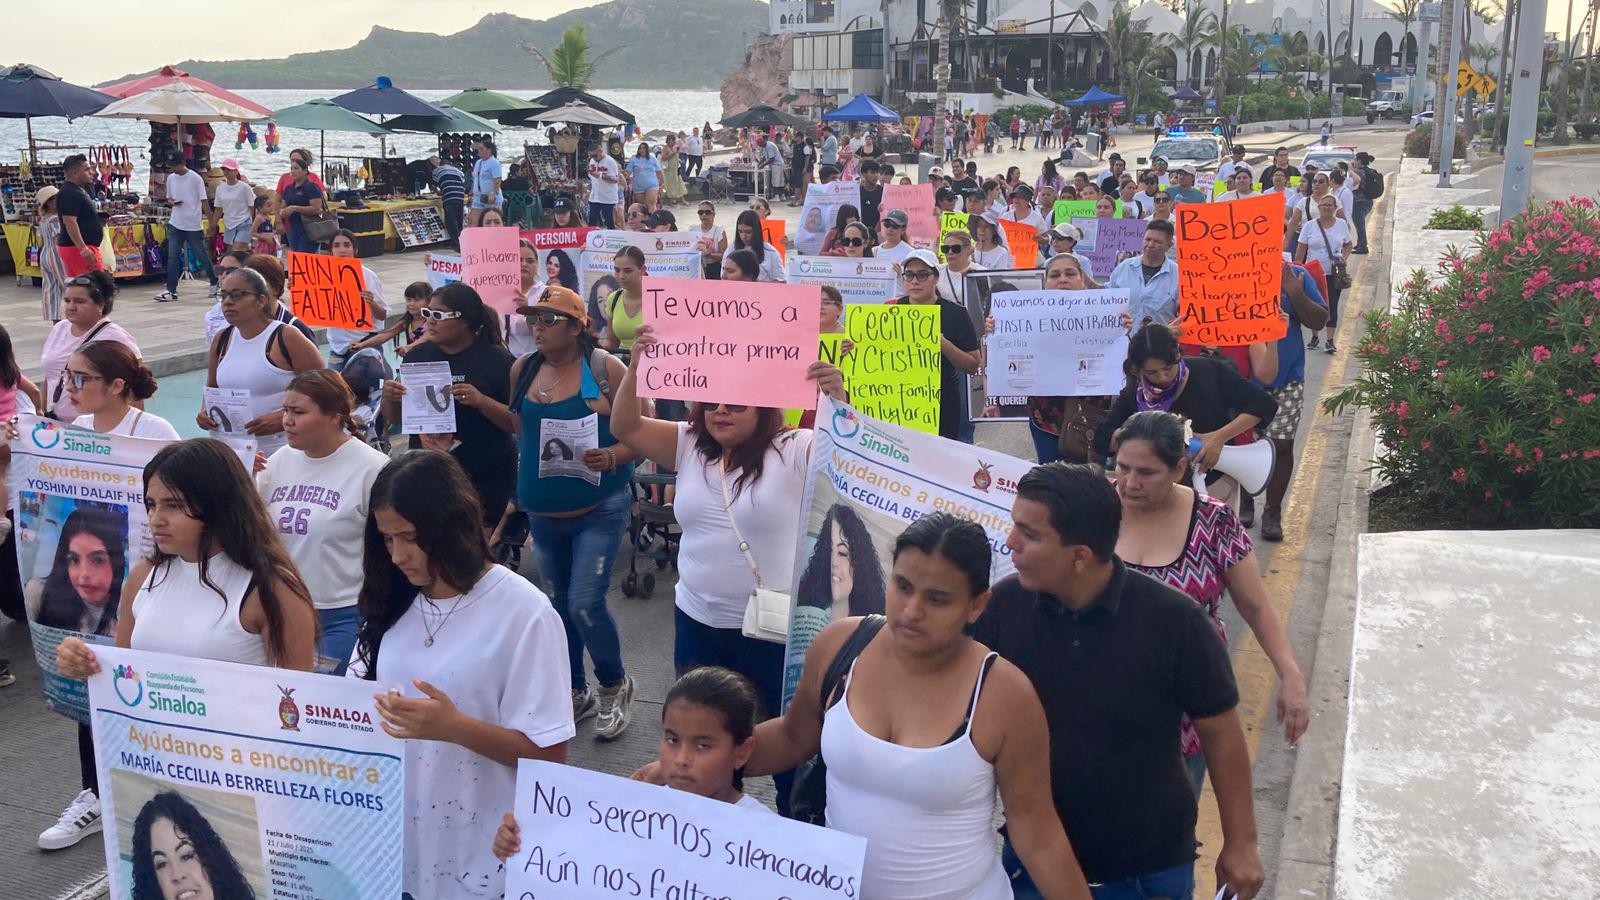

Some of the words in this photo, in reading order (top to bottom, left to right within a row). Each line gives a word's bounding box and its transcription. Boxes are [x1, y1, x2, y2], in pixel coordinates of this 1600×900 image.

[1180, 203, 1270, 241] Bebe
[535, 231, 578, 246] PERSONA
[1180, 248, 1208, 261] Los
[469, 273, 520, 288] queremos
[1182, 270, 1205, 288] que
[646, 289, 677, 318] Te
[685, 298, 762, 321] vamos
[781, 306, 797, 322] a
[993, 298, 1006, 308] No
[1010, 297, 1045, 306] vamos
[1047, 298, 1056, 306] a
[1084, 297, 1097, 305] de
[1100, 296, 1128, 304] luchar
[849, 306, 938, 344] Cecilia
[645, 336, 737, 359] encontrar
[747, 344, 799, 361] prima
[864, 343, 940, 373] Cristina
[646, 366, 708, 390] Cecilia
[63, 438, 112, 455] Sinaloa
[859, 433, 910, 464] Sinaloa
[127, 476, 136, 486] a
[832, 450, 911, 497] Ayúdanos
[918, 491, 928, 504] a
[27, 478, 77, 495] YOSHIMI
[127, 492, 143, 504] HE
[270, 486, 288, 503] OS
[286, 485, 341, 511] ANGELES
[851, 487, 898, 515] CECILIA
[278, 506, 311, 535] 26
[148, 691, 207, 716] Sinaloa
[305, 704, 372, 724] SINALOA
[306, 718, 337, 727] GOBIERNO
[350, 724, 374, 732] ESTADO
[128, 724, 224, 760] Ayúdanos
[231, 748, 242, 764] a
[249, 751, 357, 783] encontrar
[366, 766, 380, 784] a
[121, 751, 165, 775] MARÍA
[168, 763, 221, 787] CECILIA
[226, 773, 320, 802] BERRELLEZA
[324, 788, 384, 812] FLORES
[266, 829, 284, 838] Fecha
[533, 781, 571, 817] No
[588, 800, 712, 858] seremos
[725, 840, 855, 897] silenciados
[524, 846, 579, 885] Aún
[593, 864, 642, 896] nos
